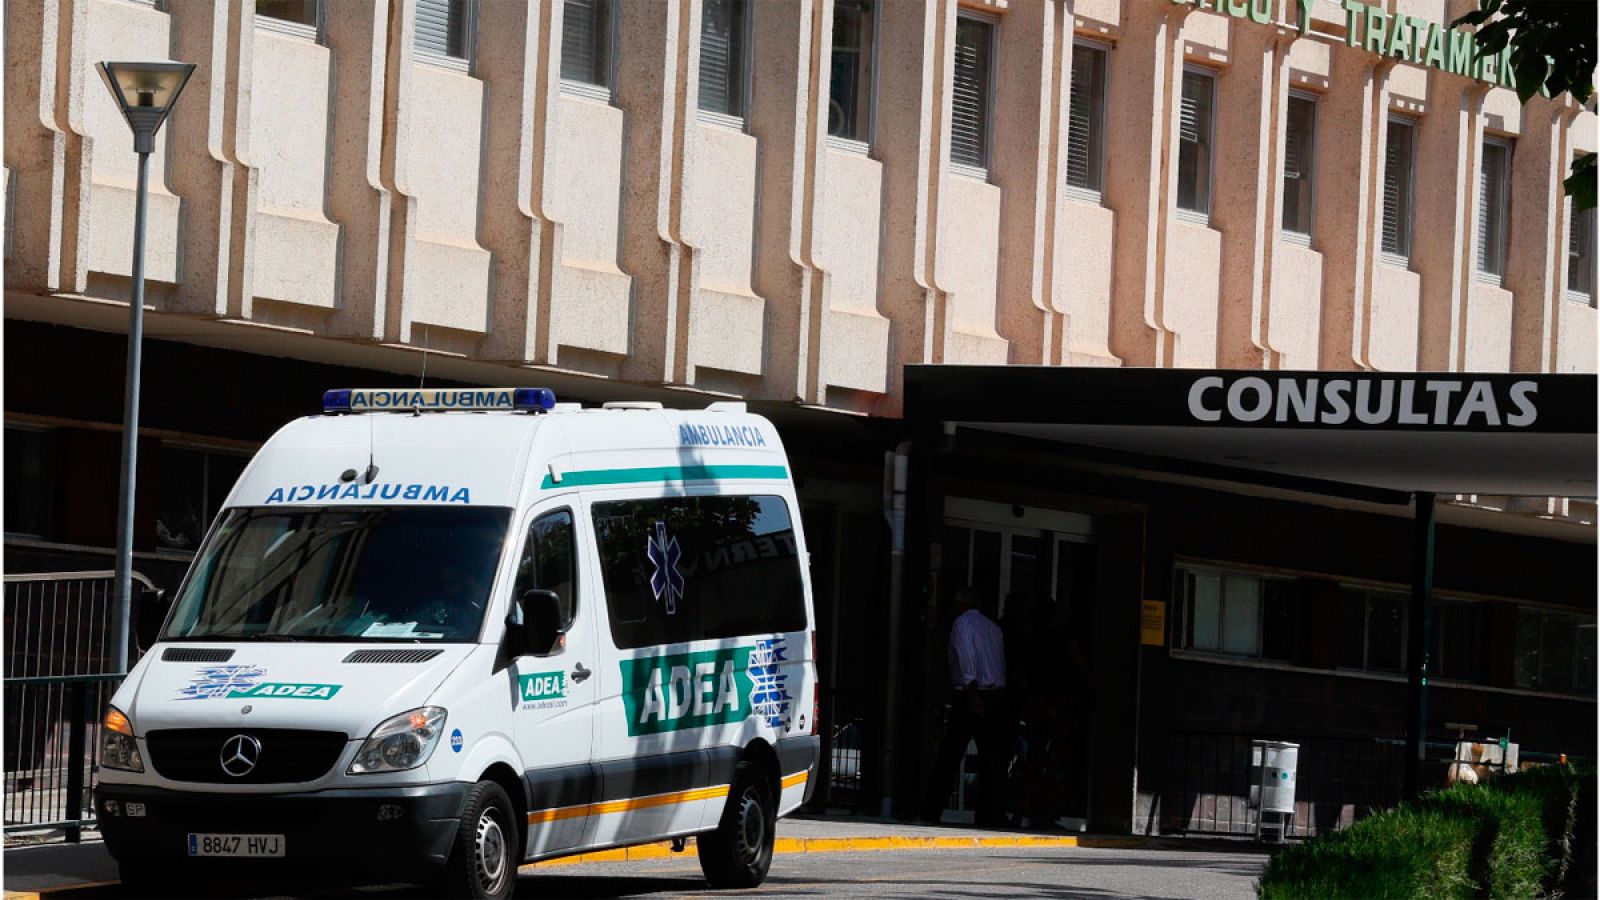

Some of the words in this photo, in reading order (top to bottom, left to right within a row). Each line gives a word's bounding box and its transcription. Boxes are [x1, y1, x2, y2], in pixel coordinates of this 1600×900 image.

[1300, 0, 1317, 35] Y
[1187, 376, 1538, 427] CONSULTAS
[679, 424, 766, 446] AMBULANCIA
[252, 685, 331, 697] ADEA
[525, 676, 560, 696] ADEA
[639, 660, 739, 724] ADEA
[203, 837, 241, 854] 8847
[248, 838, 278, 854] HVJ
